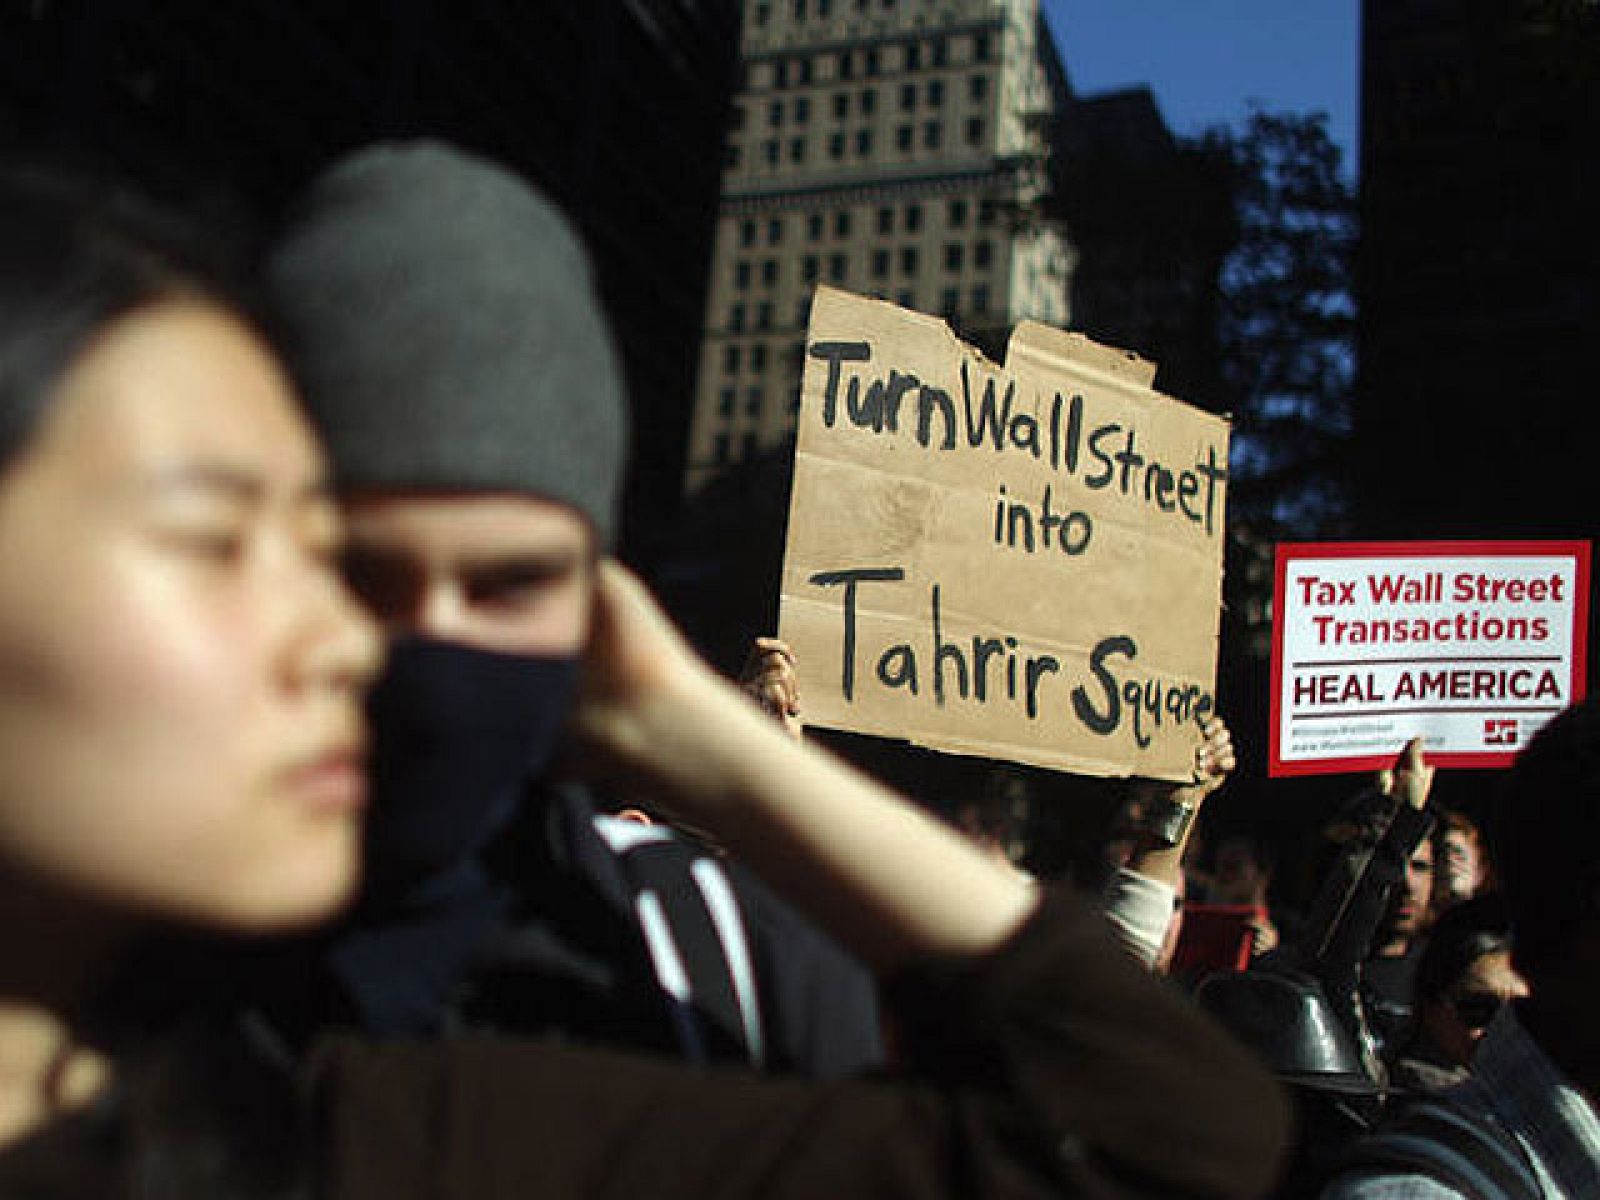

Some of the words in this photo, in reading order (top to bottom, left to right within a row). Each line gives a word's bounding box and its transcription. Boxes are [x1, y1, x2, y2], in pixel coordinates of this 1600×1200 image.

[808, 342, 956, 450] Turn
[960, 359, 1083, 475] Wall
[1084, 424, 1227, 536] Street
[994, 485, 1093, 555] into
[1297, 576, 1355, 606] Tax
[1368, 572, 1443, 605] Wall
[1452, 573, 1563, 603] Street
[1312, 610, 1549, 646] Transactions
[808, 567, 1060, 720] Tahrir
[1070, 635, 1214, 749] Square
[1293, 673, 1385, 705] HEAL
[1393, 669, 1561, 701] AMERICA
